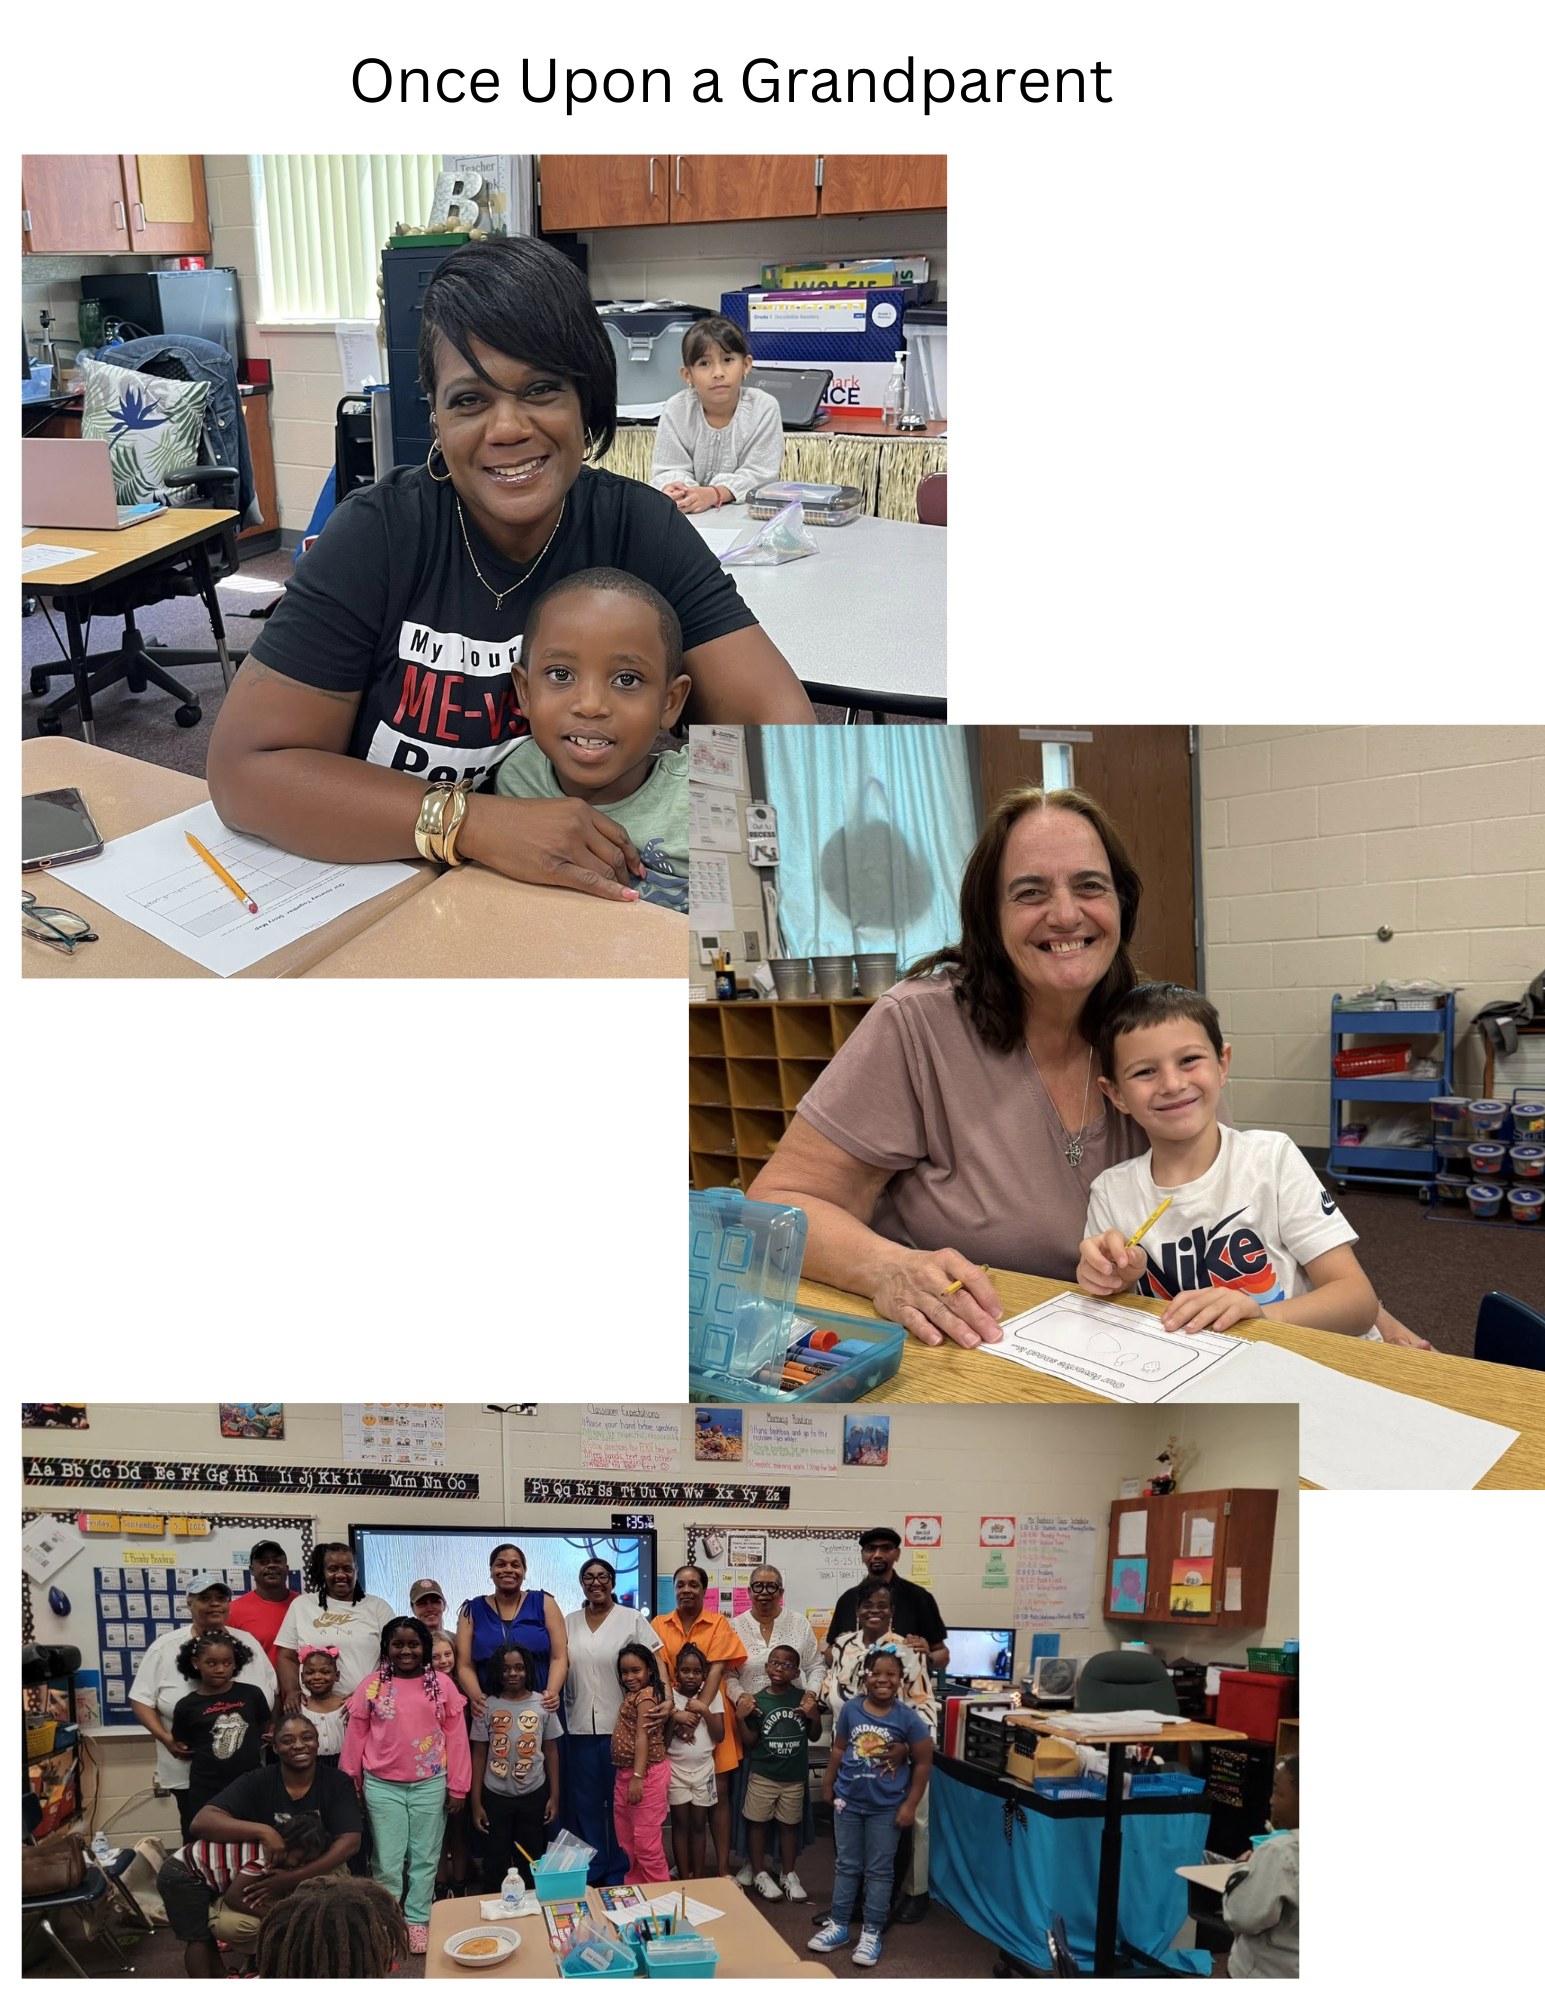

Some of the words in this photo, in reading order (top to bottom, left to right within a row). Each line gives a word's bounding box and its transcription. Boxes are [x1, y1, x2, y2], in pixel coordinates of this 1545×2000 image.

[460, 161, 496, 172] Teacher
[410, 629, 443, 664] My
[460, 641, 517, 668] Jour
[750, 831, 776, 839] RECESS
[1137, 1225, 1269, 1301] Nike
[1026, 1349, 1059, 1366] snack
[1057, 1359, 1102, 1382] favorite
[1101, 1377, 1126, 1390] Our
[587, 1403, 618, 1416] Classroom
[621, 1405, 660, 1418] Expectations
[605, 1421, 617, 1429] your
[620, 1419, 635, 1429] hand
[766, 1412, 788, 1425] Morning
[792, 1413, 813, 1425] Routine
[818, 1428, 828, 1438] the
[29, 1462, 55, 1477] Aa
[61, 1463, 84, 1478] Bb
[90, 1464, 111, 1479] Cc
[117, 1466, 141, 1480] Dd
[154, 1466, 175, 1481] Ee
[181, 1467, 201, 1482] Ff
[206, 1468, 229, 1485] Gg
[235, 1469, 259, 1483] Hh
[279, 1471, 293, 1484] Ii
[299, 1472, 314, 1488] Jj
[318, 1472, 342, 1486] Kk
[347, 1473, 362, 1486] Ll
[389, 1474, 417, 1488] Mm
[422, 1475, 443, 1489] Nn
[447, 1477, 467, 1490] Oo
[532, 1481, 549, 1497] Pp
[553, 1482, 571, 1498] Qq
[576, 1483, 594, 1497] Rr
[598, 1484, 613, 1497] Ss
[621, 1485, 636, 1498] Tt
[640, 1486, 657, 1499] Uu
[661, 1487, 679, 1499] Vv
[682, 1487, 704, 1499] Ww
[715, 1488, 734, 1500] Xx
[741, 1488, 758, 1503] Yy
[766, 1489, 780, 1501] Zz
[122, 1519, 160, 1529] September
[189, 1520, 206, 1531] 2025
[820, 1542, 852, 1553] September
[131, 1551, 150, 1564] Ready
[150, 1552, 175, 1564] Reading
[320, 1611, 353, 1623] NIKE
[769, 1741, 783, 1749] NEW
[784, 1741, 801, 1749] YORK
